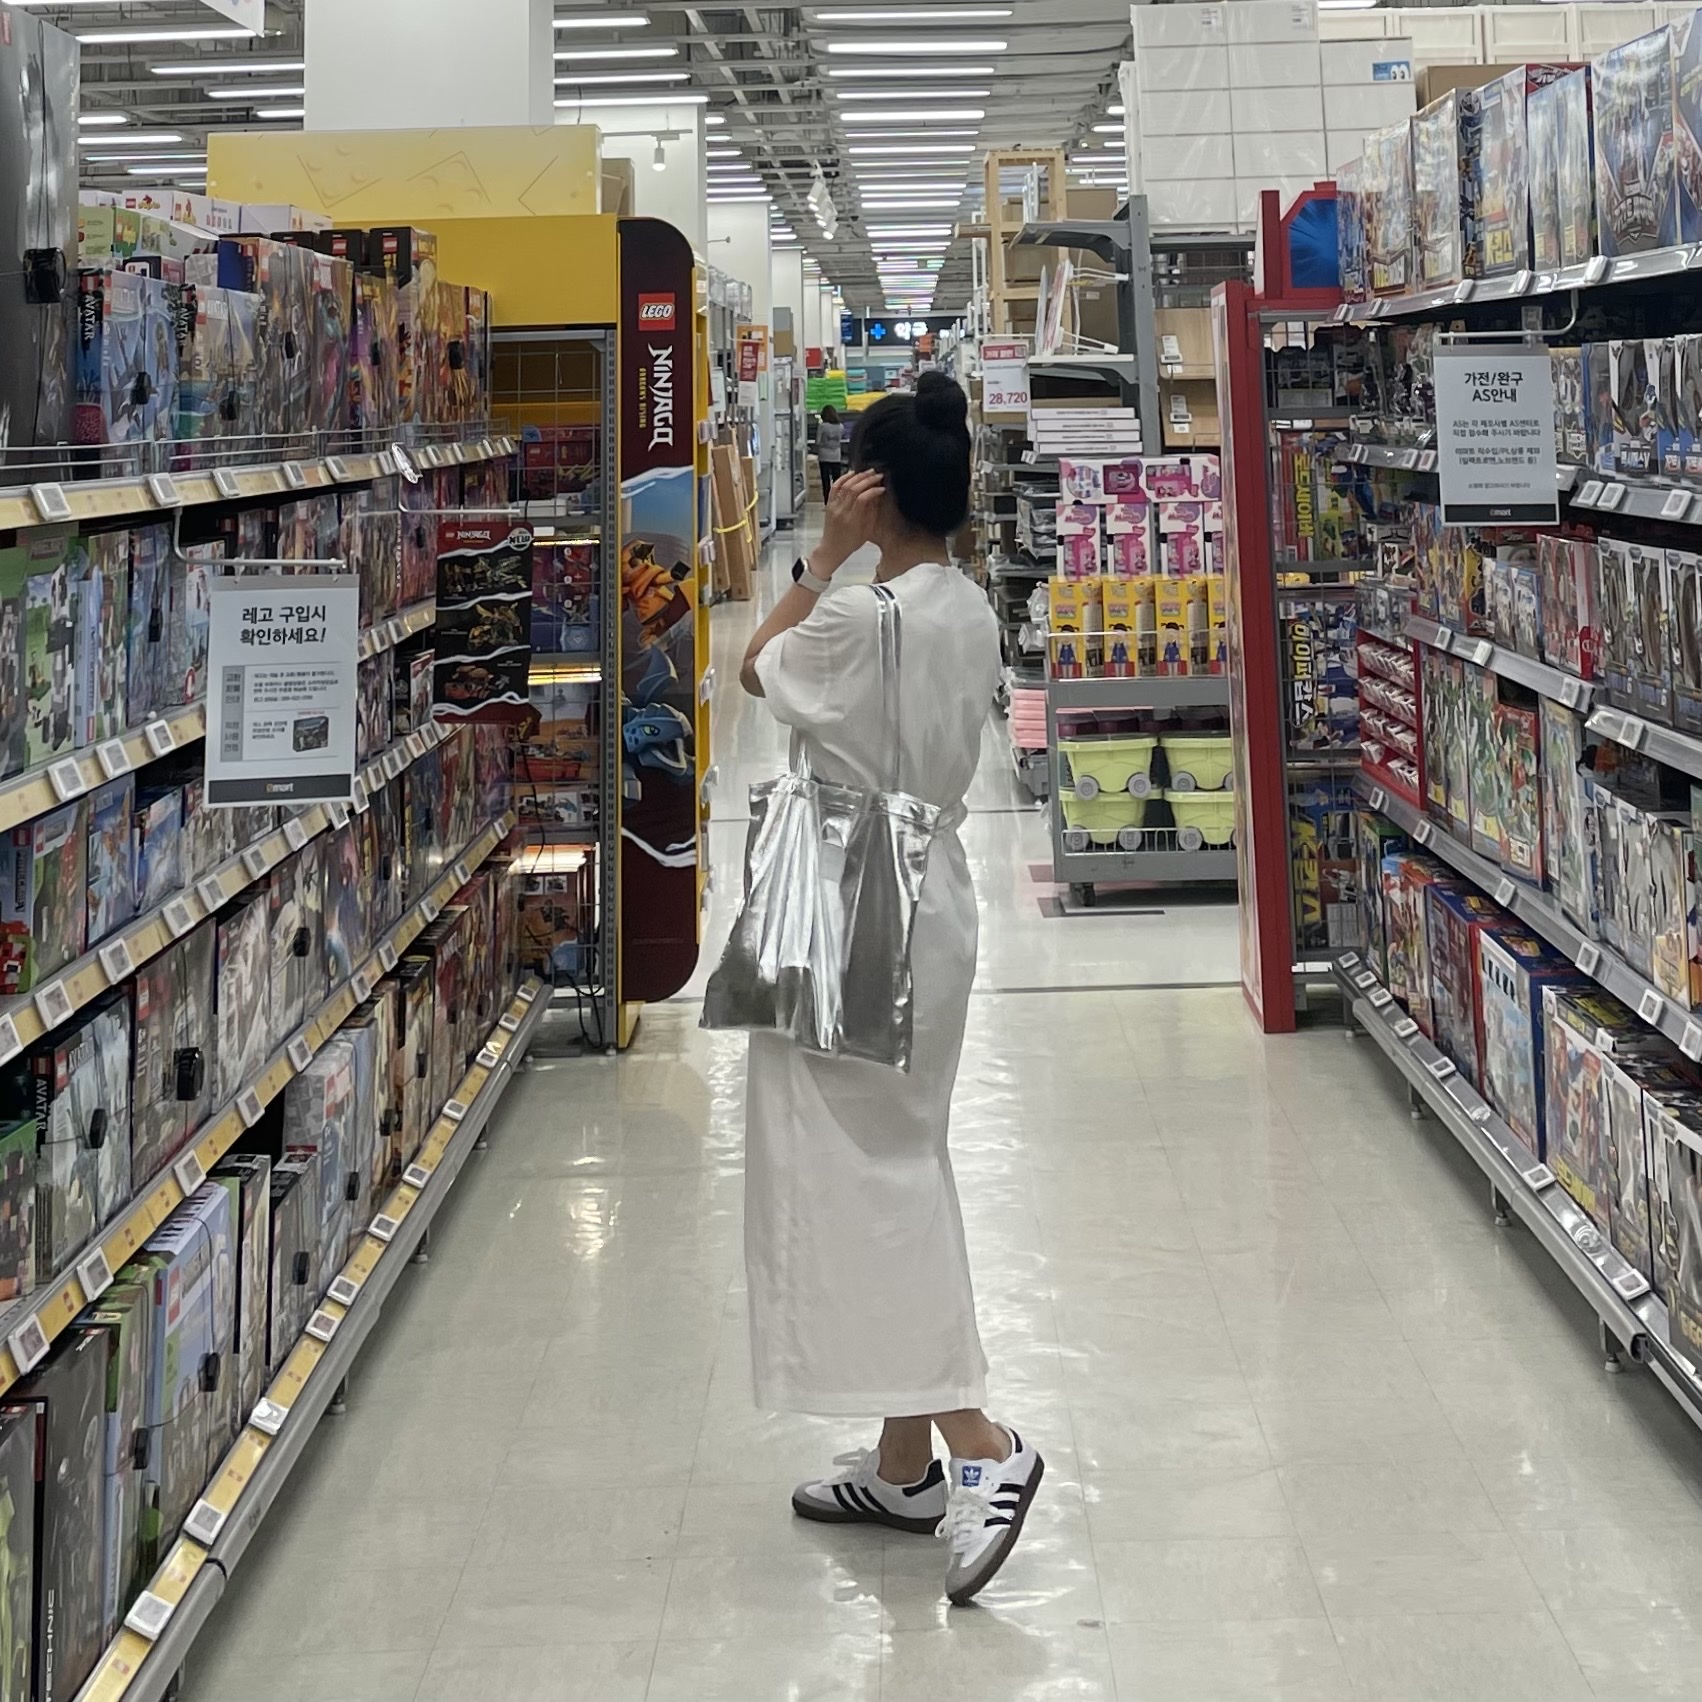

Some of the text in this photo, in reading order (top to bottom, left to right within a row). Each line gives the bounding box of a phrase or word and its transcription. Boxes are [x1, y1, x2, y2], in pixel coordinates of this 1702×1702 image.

[83, 294, 96, 340] AVATAR
[641, 303, 674, 320] LEGO
[1464, 372, 1523, 386] 가전/완구
[648, 342, 673, 452] NINJAGO
[989, 392, 1028, 405] 28,720
[1472, 389, 1517, 403] AS안내
[509, 535, 532, 545] NEW
[242, 605, 326, 624] 레고 구입시
[240, 627, 327, 646] 확인하세요!
[266, 782, 294, 793] emart
[35, 1078, 48, 1131] AVATAR
